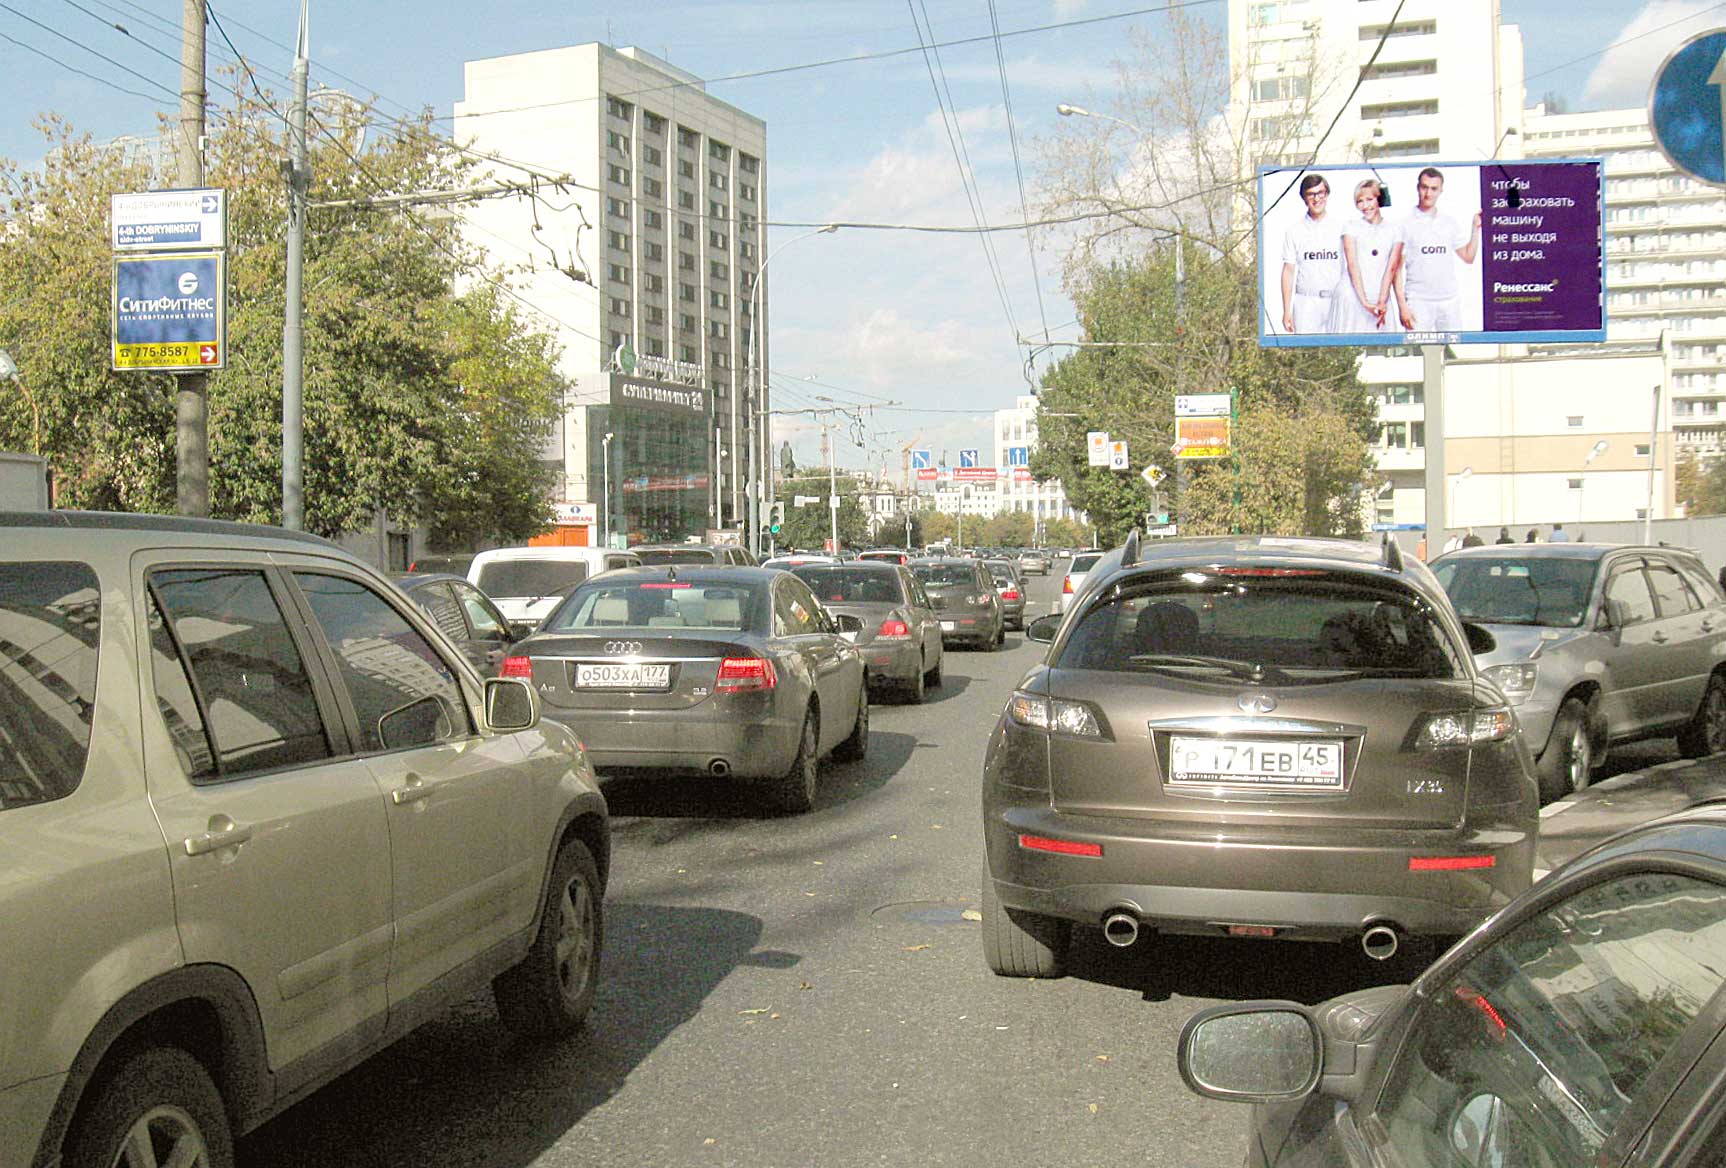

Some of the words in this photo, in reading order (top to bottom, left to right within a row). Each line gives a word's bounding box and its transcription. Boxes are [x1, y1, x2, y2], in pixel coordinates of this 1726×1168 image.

[1491, 177, 1530, 190] чтобы
[1492, 197, 1575, 210] засраховать
[1492, 215, 1544, 228] машину
[136, 223, 199, 235] DOBRYNINSKIY
[1492, 233, 1509, 243] не
[1511, 232, 1557, 244] выходя
[1304, 249, 1339, 260] renins
[1421, 245, 1446, 255] com
[1492, 250, 1509, 261] из
[1511, 249, 1546, 261] дома.
[1493, 282, 1554, 293] Ренессанс
[135, 346, 189, 358] 775-8587
[643, 665, 667, 677] 177
[1302, 747, 1329, 766] 45
